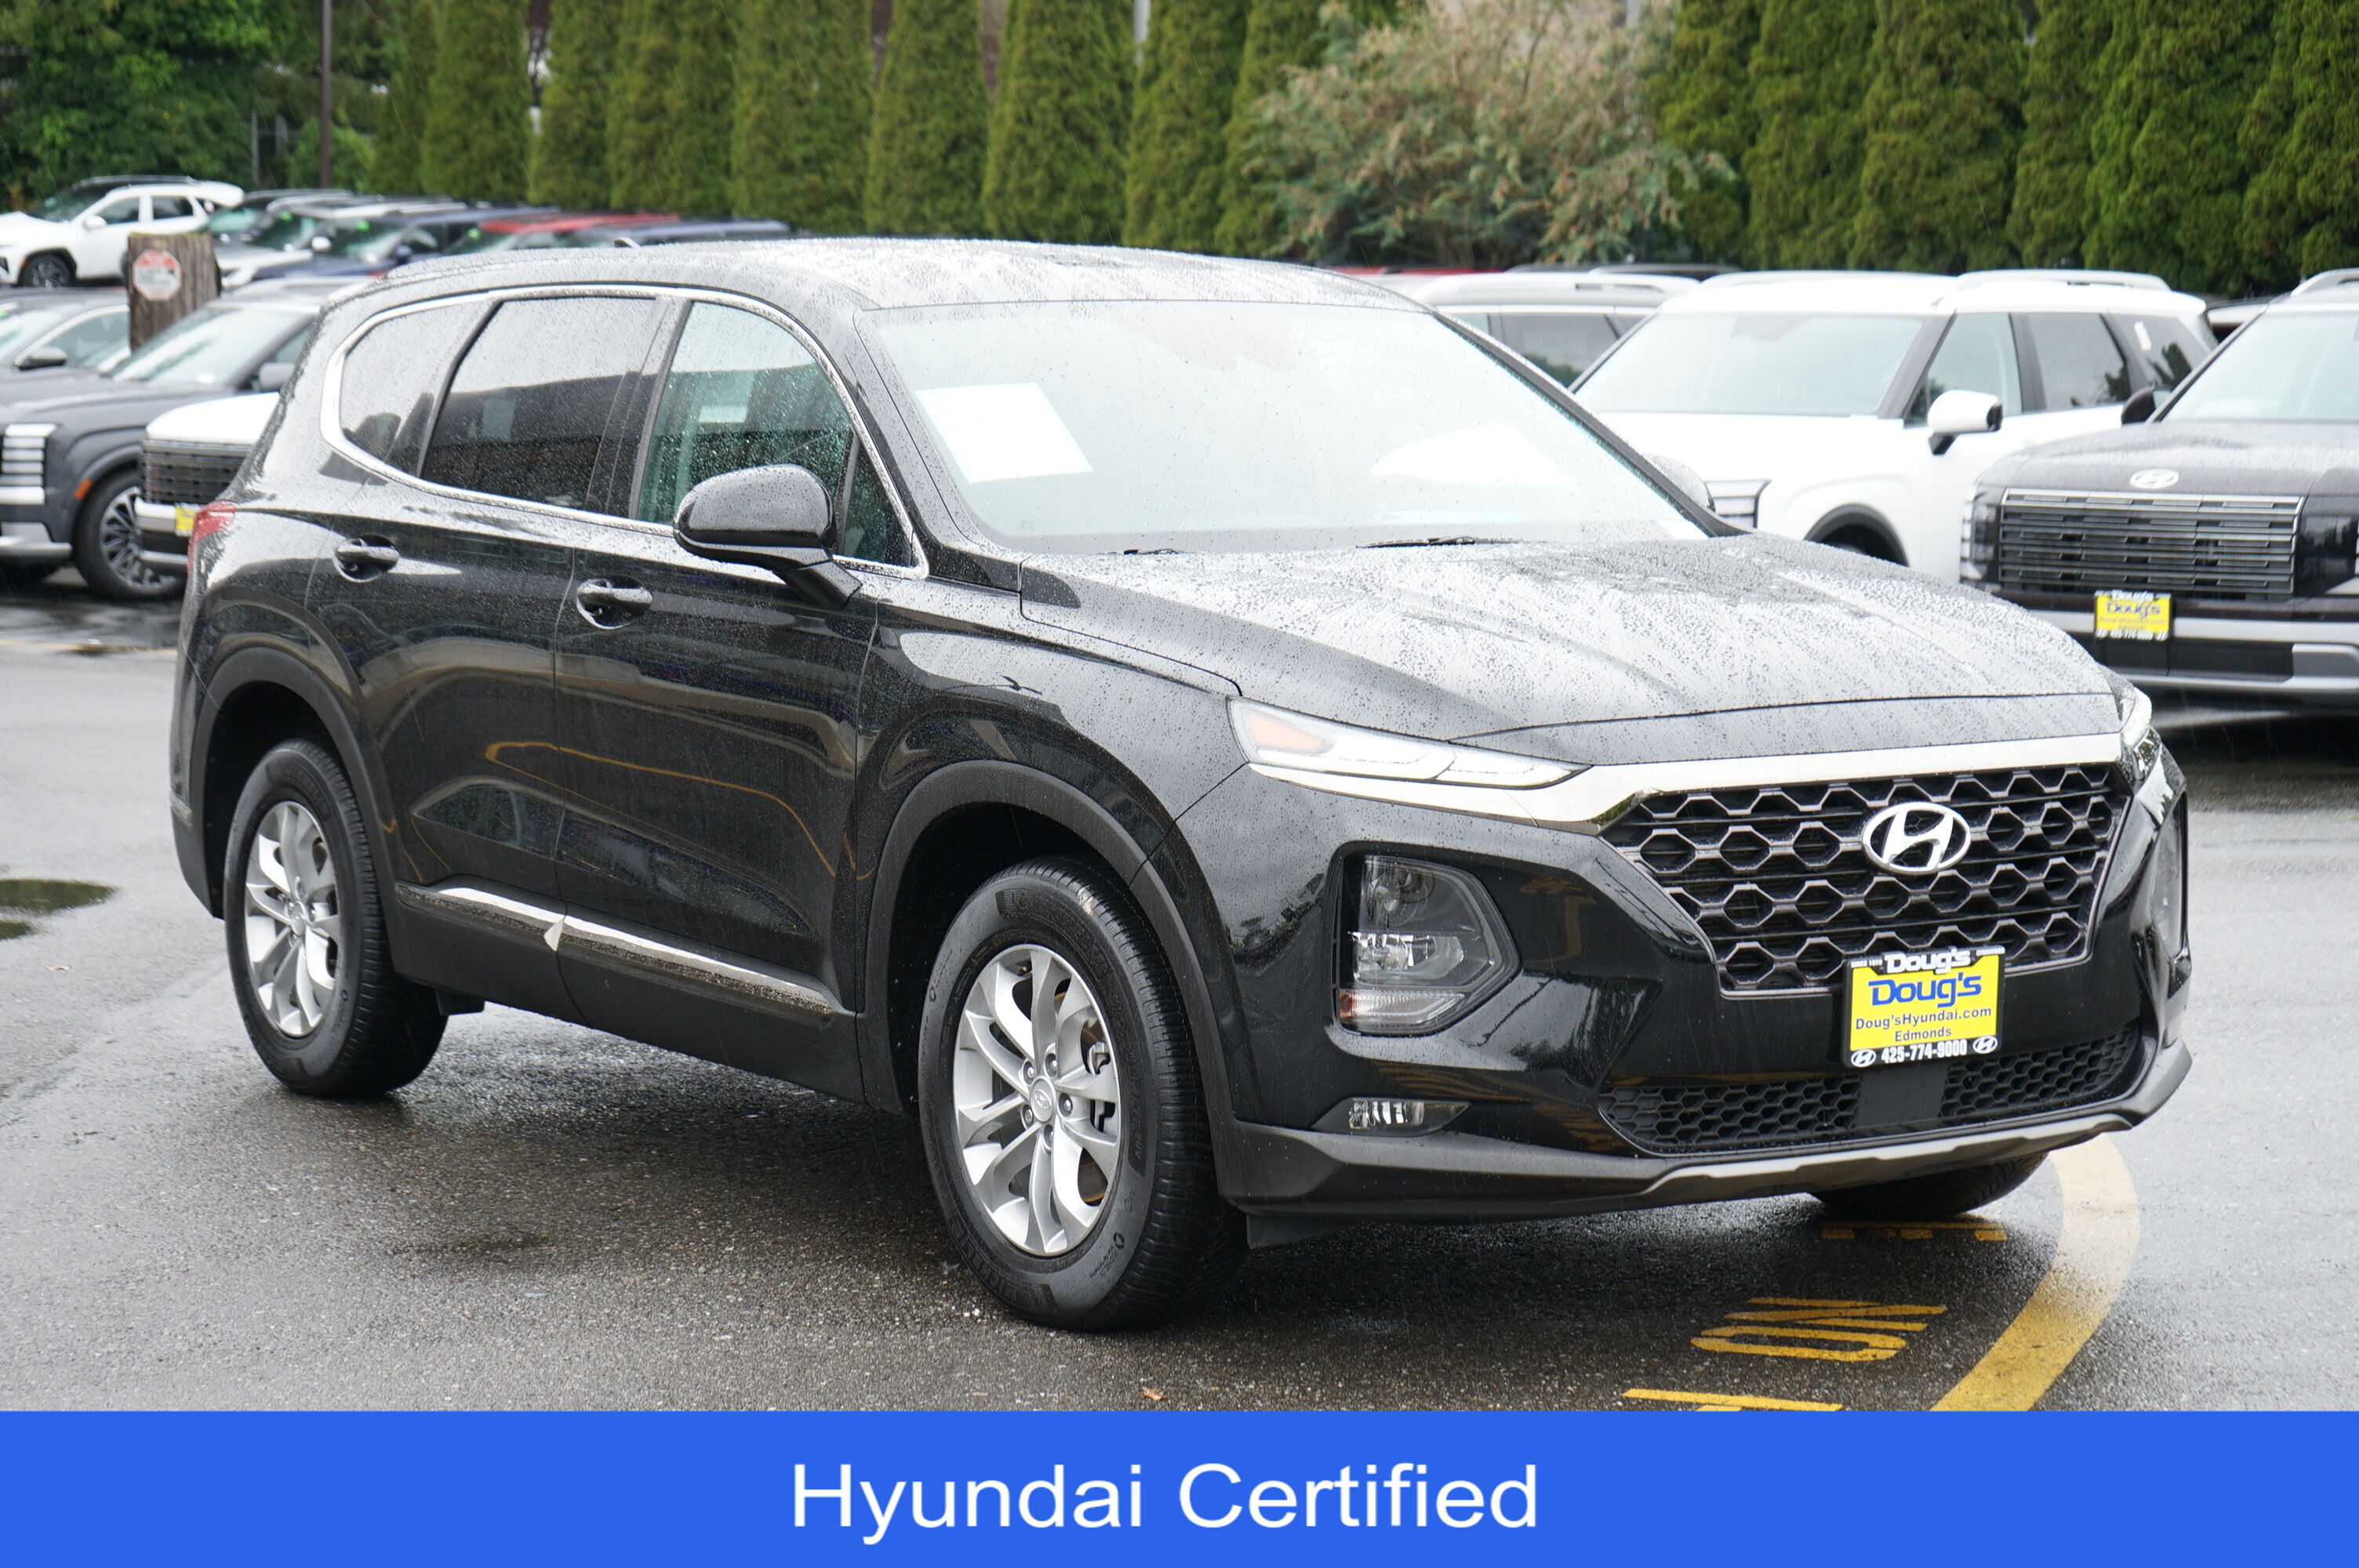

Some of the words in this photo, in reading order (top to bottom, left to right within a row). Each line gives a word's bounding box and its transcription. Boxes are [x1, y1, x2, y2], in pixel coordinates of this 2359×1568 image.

[1885, 946, 1971, 975] Doug's
[1868, 972, 1982, 1007] Doug's
[1856, 1007, 1992, 1030] Doug'sHyundai.com
[1895, 1027, 1952, 1042] Edmonds
[1881, 1039, 1968, 1065] 425-774-9000
